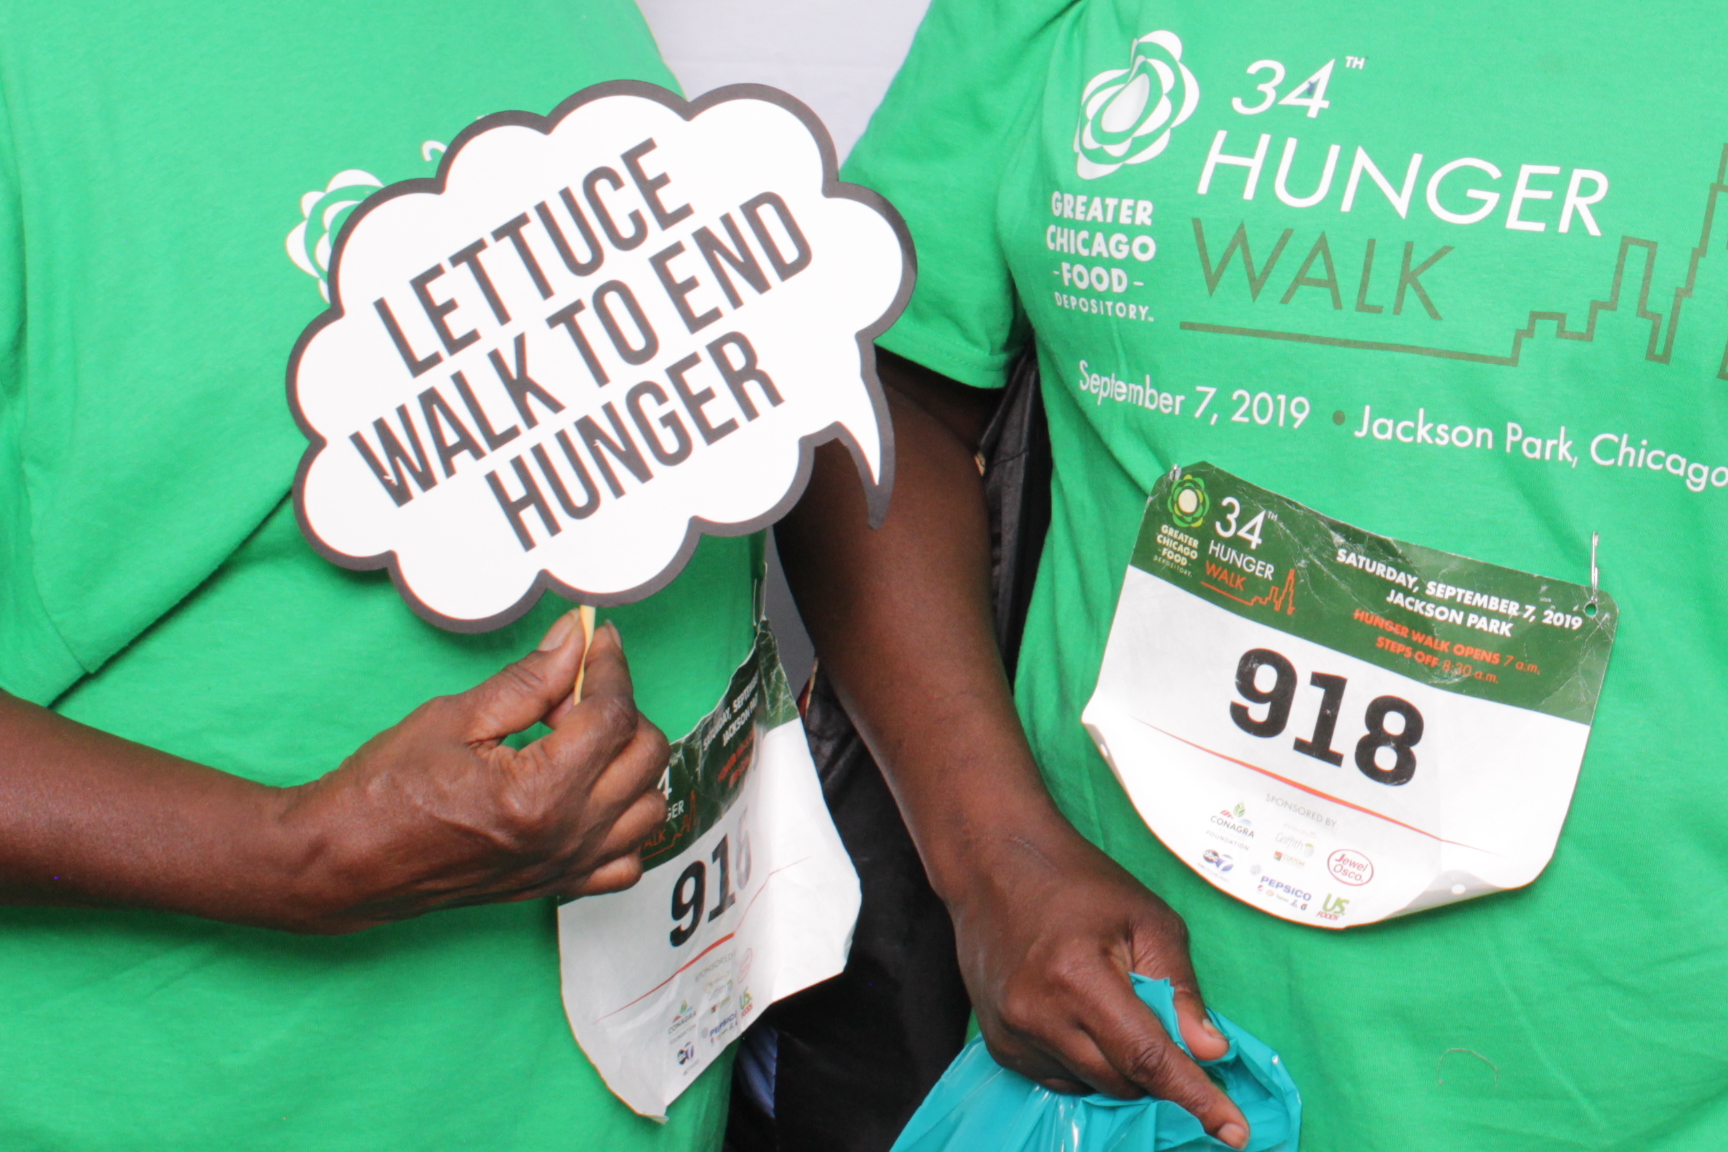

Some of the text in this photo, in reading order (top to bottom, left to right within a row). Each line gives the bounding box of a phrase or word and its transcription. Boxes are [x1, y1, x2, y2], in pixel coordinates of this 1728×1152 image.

[1197, 129, 1610, 237] HUNGER
[1051, 190, 1154, 226] GREATER
[372, 136, 695, 379] LETTUCE
[1046, 224, 1157, 262] CHICAGO
[1191, 217, 1456, 322] WALK
[347, 191, 813, 508] WALK TO END
[1079, 359, 1186, 416] September
[1194, 385, 1219, 426] 7,
[1231, 390, 1311, 430] 2019
[1354, 406, 1495, 452] Jackson
[1506, 422, 1580, 469] Park,
[483, 330, 786, 553] HUNGER
[1156, 534, 1199, 560] CHICAGO
[1160, 523, 1199, 549] GREATER
[1205, 560, 1248, 591] WALK
[1208, 540, 1275, 581] HUNGER
[1336, 548, 1583, 631] SATURDAY, SEPTEMBER 7, 2019
[1386, 589, 1515, 637] JACKSON PARK
[1353, 608, 1410, 638] HUNGER
[1411, 629, 1452, 653] WALK
[1452, 643, 1501, 666] OPENS
[1502, 655, 1515, 667] 7
[1375, 636, 1413, 659] STEPS
[1413, 651, 1440, 668] OFF
[1229, 647, 1425, 787] 918
[1210, 815, 1255, 839] CONAGRA
[1265, 793, 1324, 823] SPONSORED
[1260, 875, 1312, 902] PEPSICO
